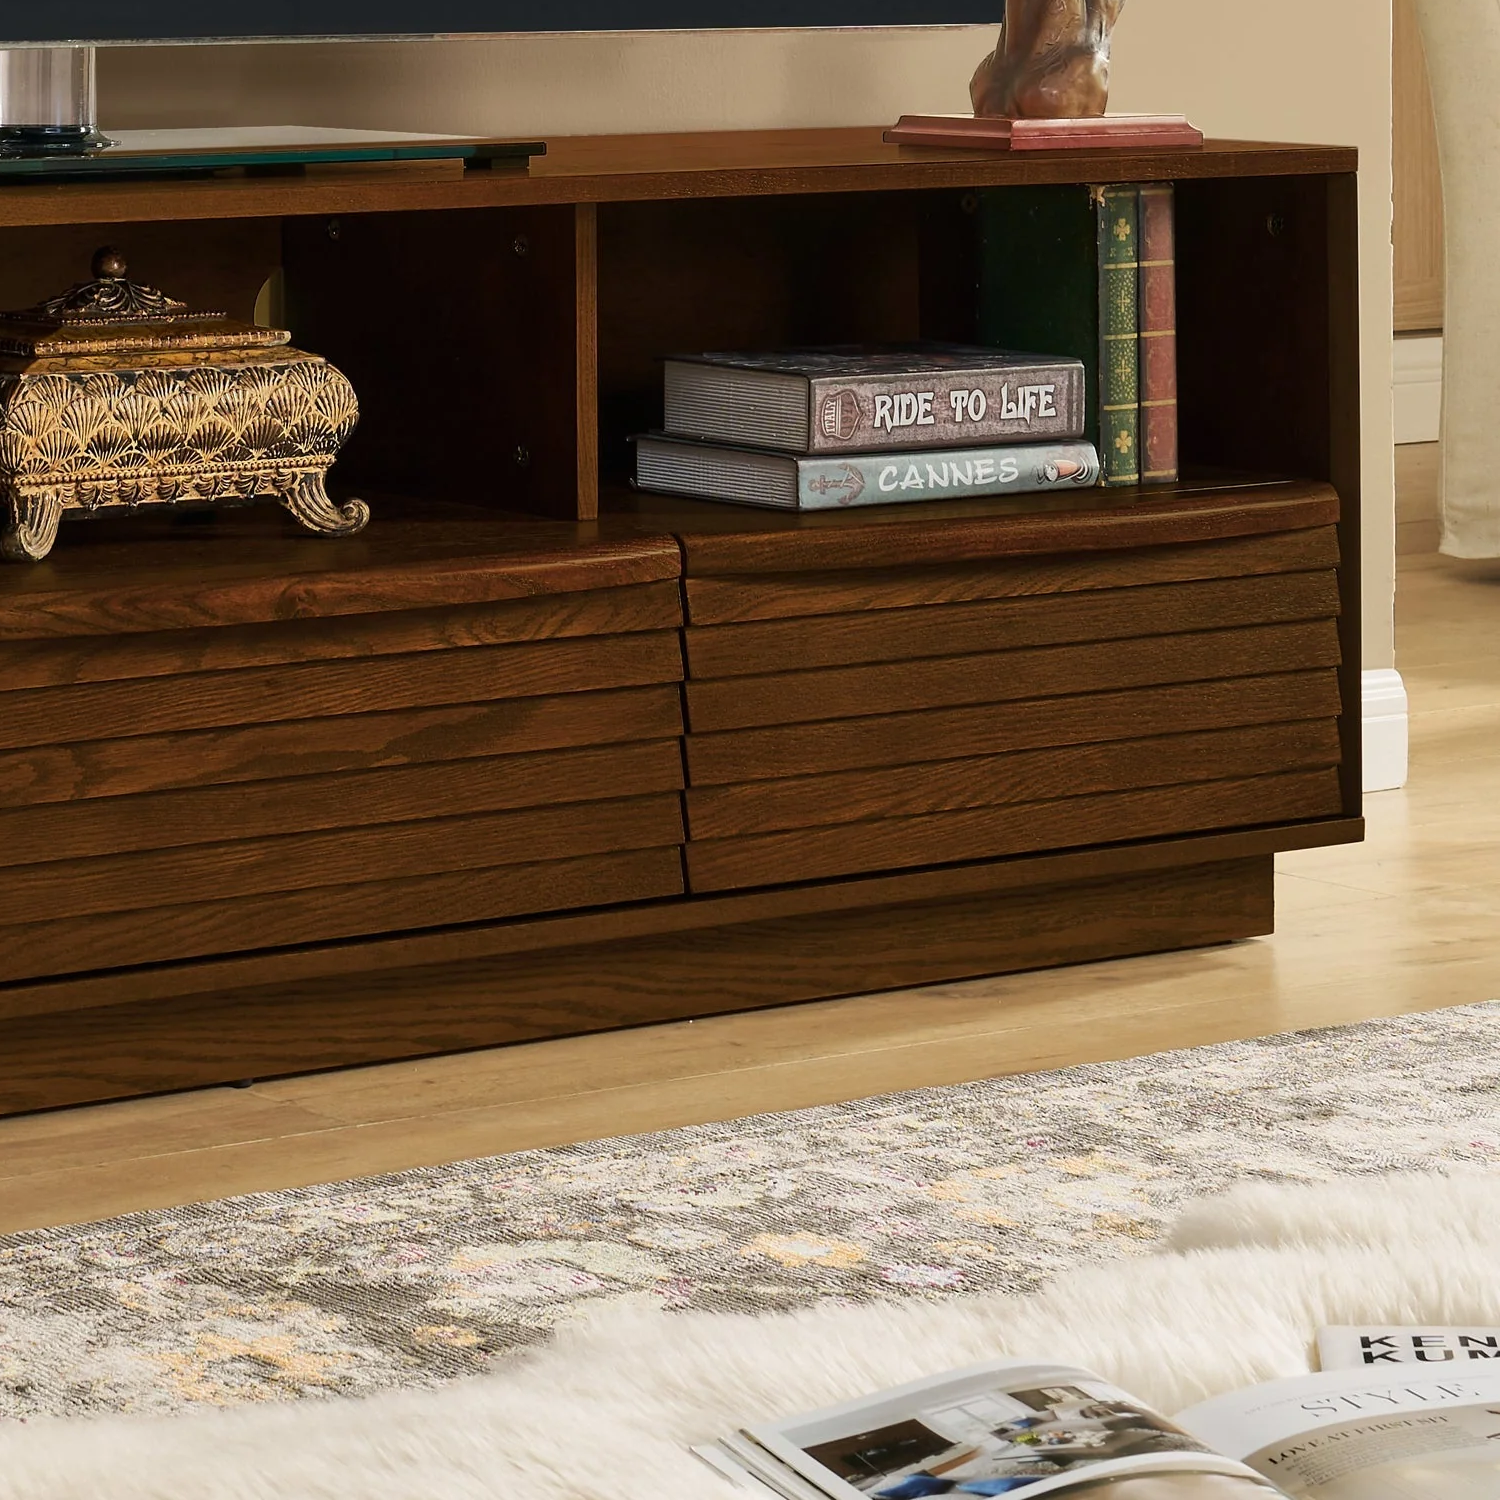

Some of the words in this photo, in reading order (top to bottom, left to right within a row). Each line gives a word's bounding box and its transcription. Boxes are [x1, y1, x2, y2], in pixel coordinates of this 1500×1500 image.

[824, 400, 836, 433] ITALY
[873, 392, 935, 433] RIDE
[950, 388, 987, 422] TO
[1000, 382, 1057, 425] LIFE
[878, 457, 1019, 492] CANNES
[1301, 1383, 1481, 1418] STYLE
[1268, 1437, 1323, 1465] LOVE
[1354, 1419, 1413, 1435] FIRST
